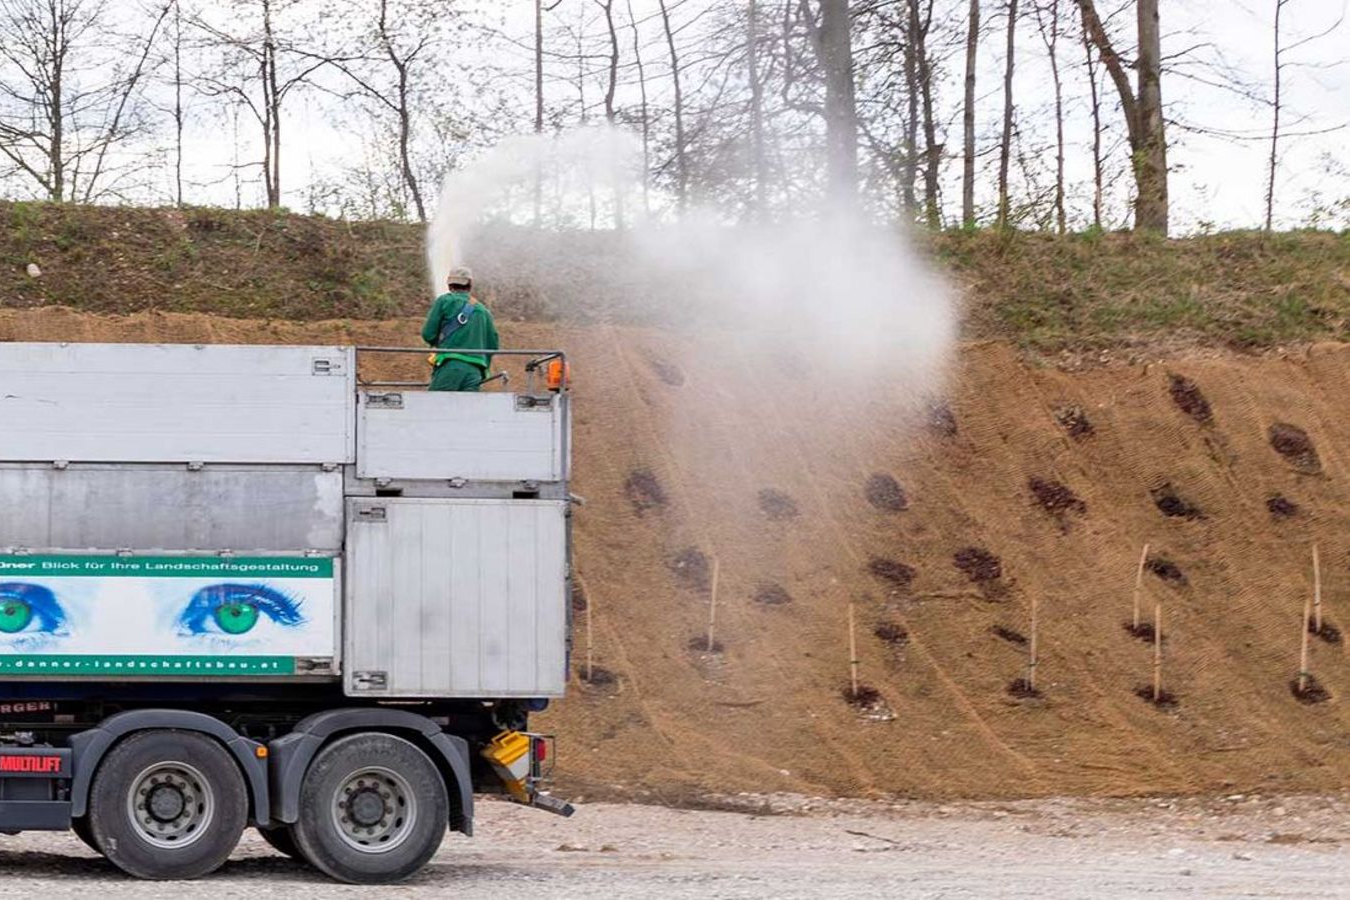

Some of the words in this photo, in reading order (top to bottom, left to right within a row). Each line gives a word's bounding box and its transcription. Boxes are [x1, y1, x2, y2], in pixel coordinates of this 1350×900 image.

[41, 561, 80, 569] Blick
[85, 561, 105, 569] für
[145, 562, 319, 571] Landschaftsgestaltung
[0, 755, 61, 772] MULTILIFT
